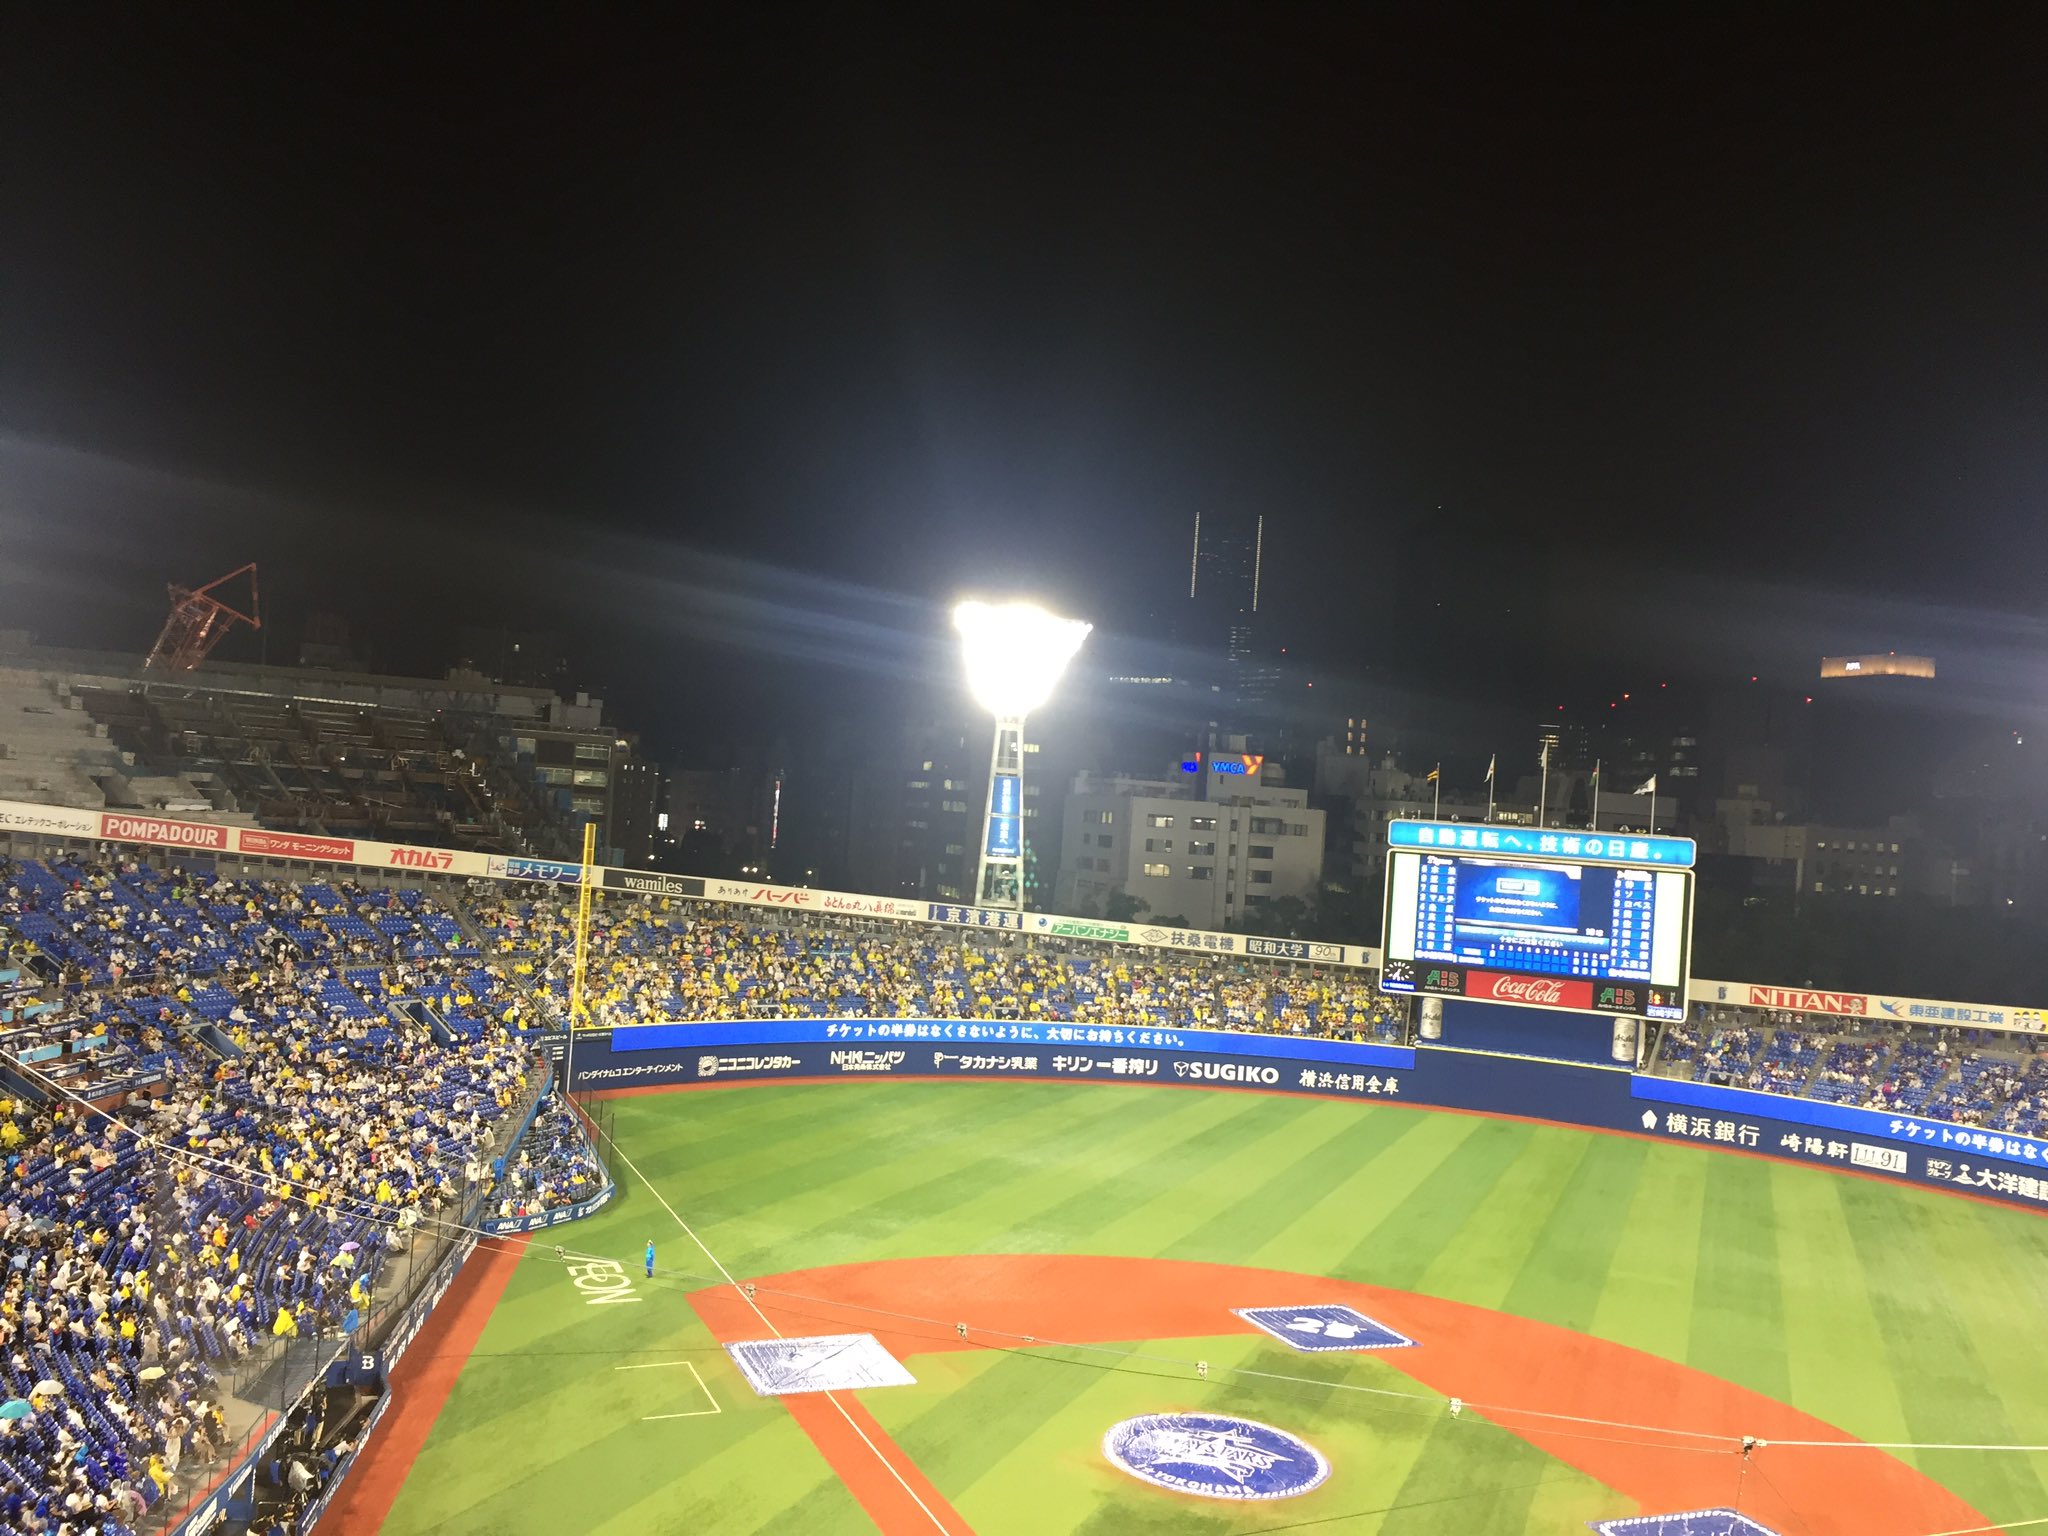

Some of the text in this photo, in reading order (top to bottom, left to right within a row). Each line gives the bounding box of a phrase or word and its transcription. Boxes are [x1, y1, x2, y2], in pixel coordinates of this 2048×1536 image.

[1212, 761, 1245, 774] YMCA
[106, 818, 219, 846] POMPADOUR
[270, 839, 351, 855] ワンダ モーニングショット
[390, 848, 453, 870] オカムラ
[519, 862, 592, 882] メモワール
[624, 876, 683, 894] wamiles
[1053, 924, 1128, 939] アーバンエナジー
[1249, 939, 1304, 957] 昭和大学
[1751, 987, 1843, 1012] NITTAN
[1909, 1004, 2005, 1025] 東亜建設工業
[577, 1063, 684, 1080] バンダイナムコ エンターテインメント
[718, 1055, 801, 1072] ニコニコレンタカー
[959, 1056, 1038, 1070] タカナシ乳業
[1052, 1055, 1159, 1076] キリン 一番搾り
[1189, 1062, 1280, 1084] SUGIKO
[1299, 1069, 1399, 1096] 横浜信用金庫
[1665, 1112, 1761, 1147] 横浜銀行
[528, 1216, 542, 1226] ANA
[553, 1211, 567, 1220] ANA
[497, 1220, 514, 1231] ANA
[361, 1355, 375, 1370] B
[1174, 1438, 1270, 1468] AYSTARS
[1155, 1470, 1256, 1494] YOKOHAMA
